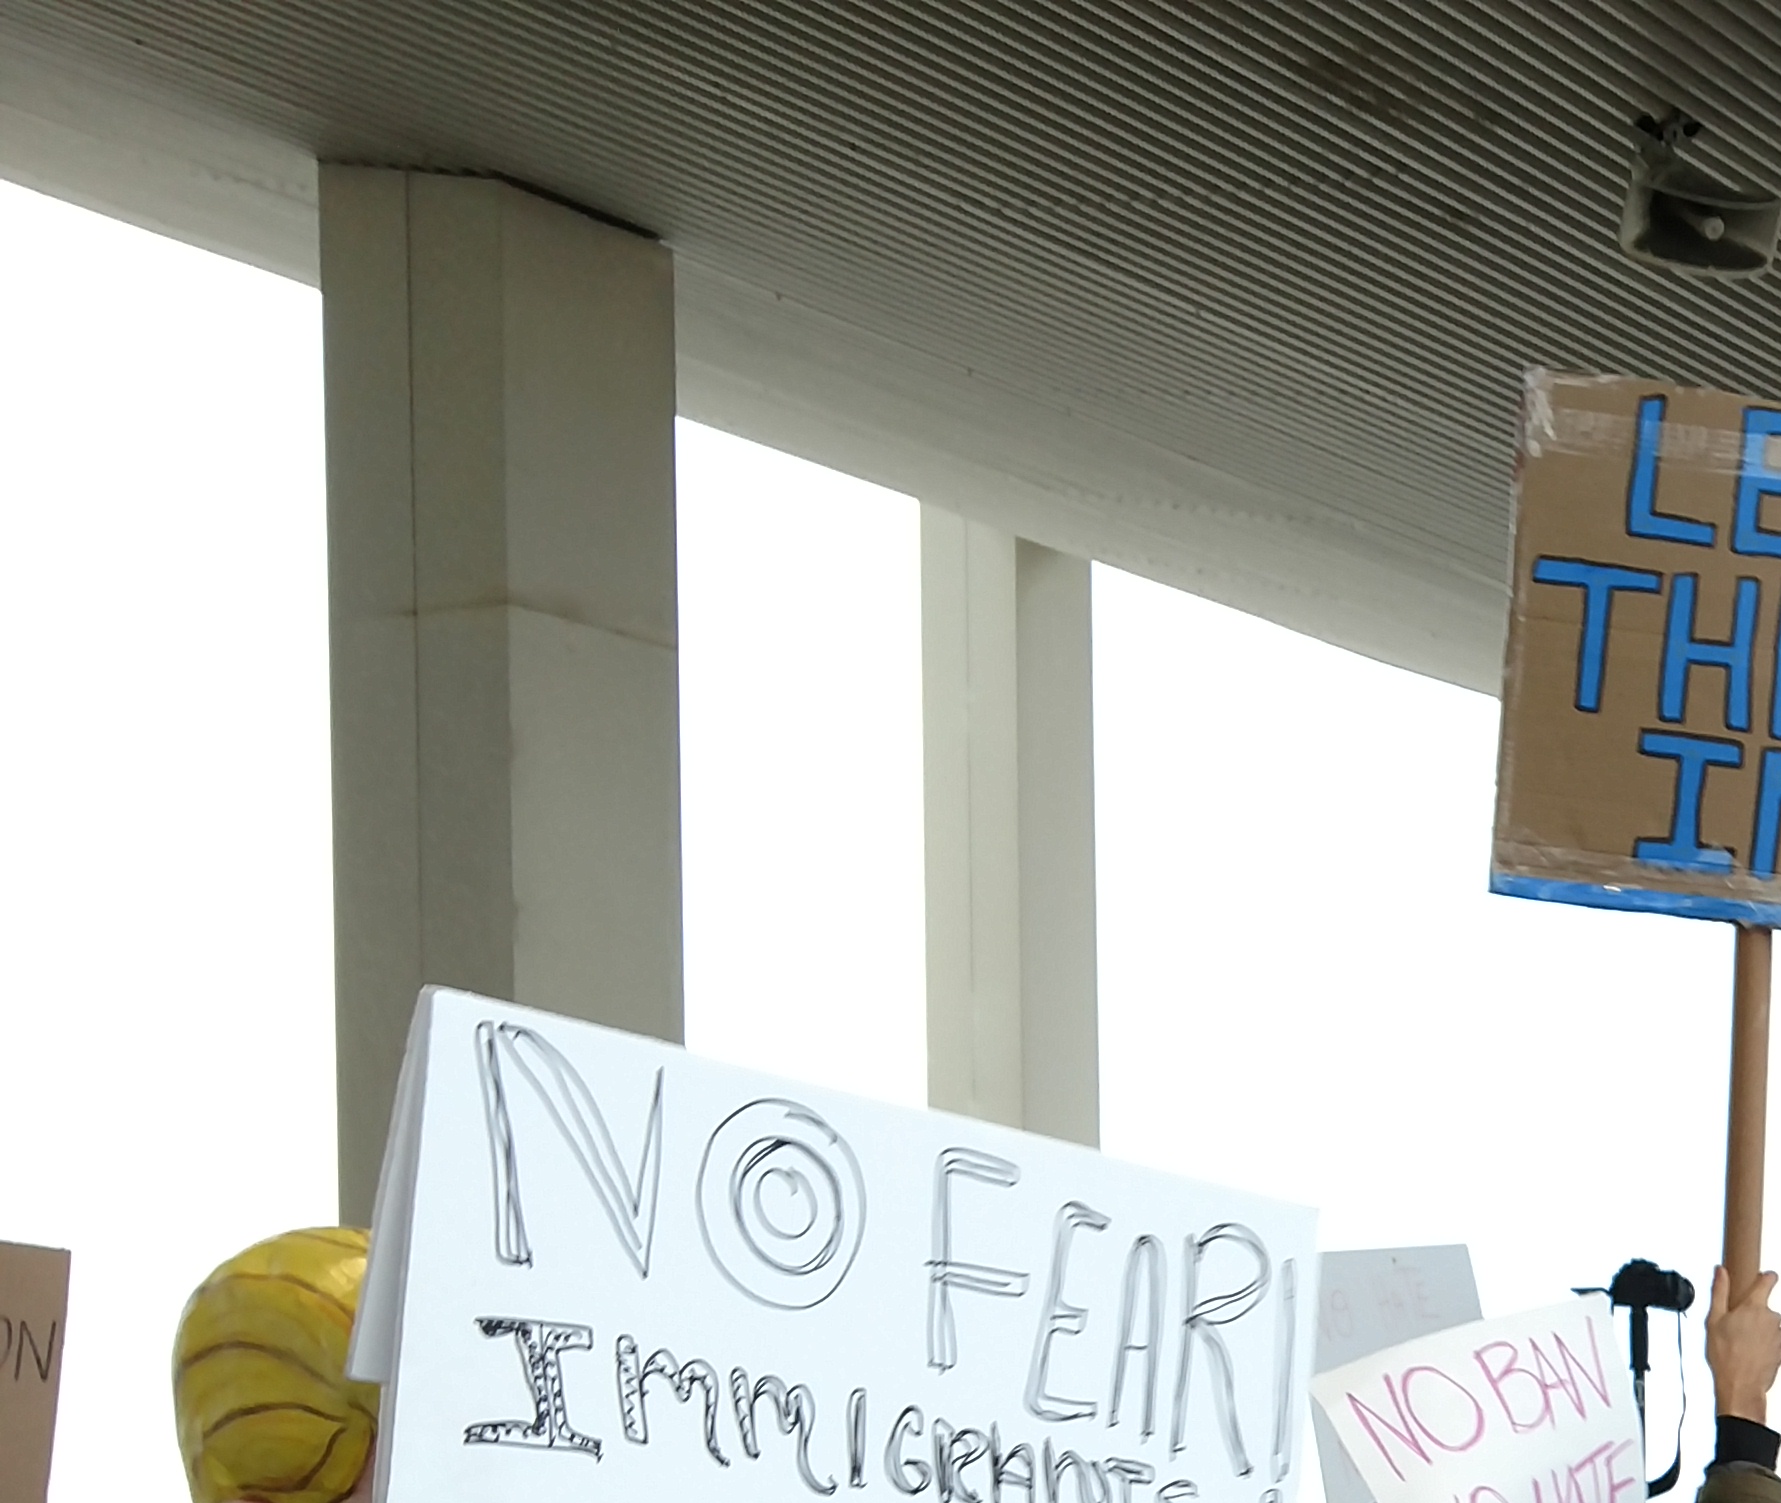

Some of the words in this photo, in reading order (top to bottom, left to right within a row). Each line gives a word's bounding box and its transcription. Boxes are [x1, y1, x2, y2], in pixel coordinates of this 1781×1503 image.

[474, 1017, 867, 1311] NO
[1346, 1366, 1485, 1483] NO
[1473, 1315, 1611, 1434] BAN
